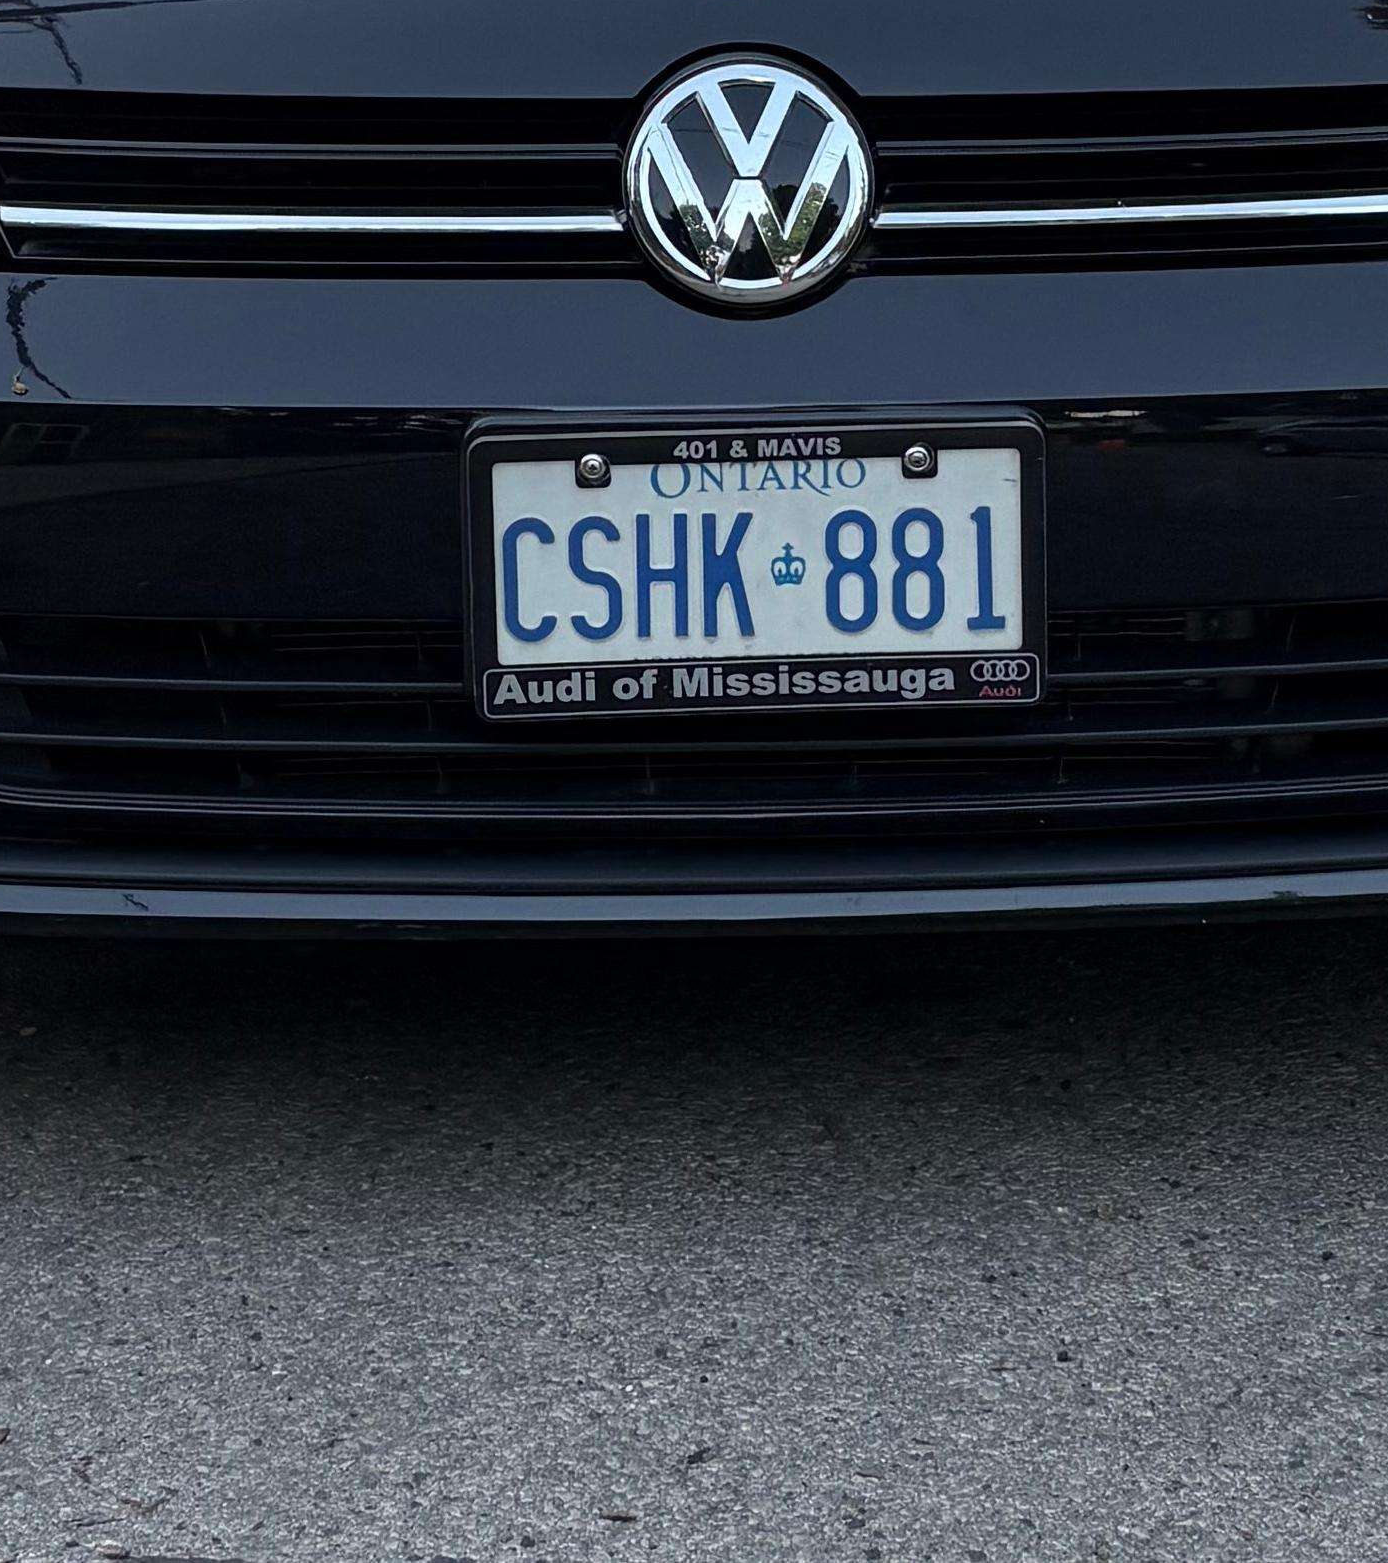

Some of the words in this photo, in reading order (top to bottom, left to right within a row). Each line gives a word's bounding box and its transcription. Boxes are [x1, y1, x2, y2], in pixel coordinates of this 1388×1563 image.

[644, 66, 852, 287] VW
[673, 440, 718, 459] 401
[729, 439, 749, 458] &
[757, 437, 842, 457] MAVIS
[650, 458, 867, 499] ONTARIO
[502, 512, 756, 644] CSHK
[824, 506, 1007, 634] 881
[493, 671, 597, 705] Audi
[612, 668, 658, 700] of
[672, 664, 956, 700] Mississauga
[978, 685, 1022, 698] Audi
